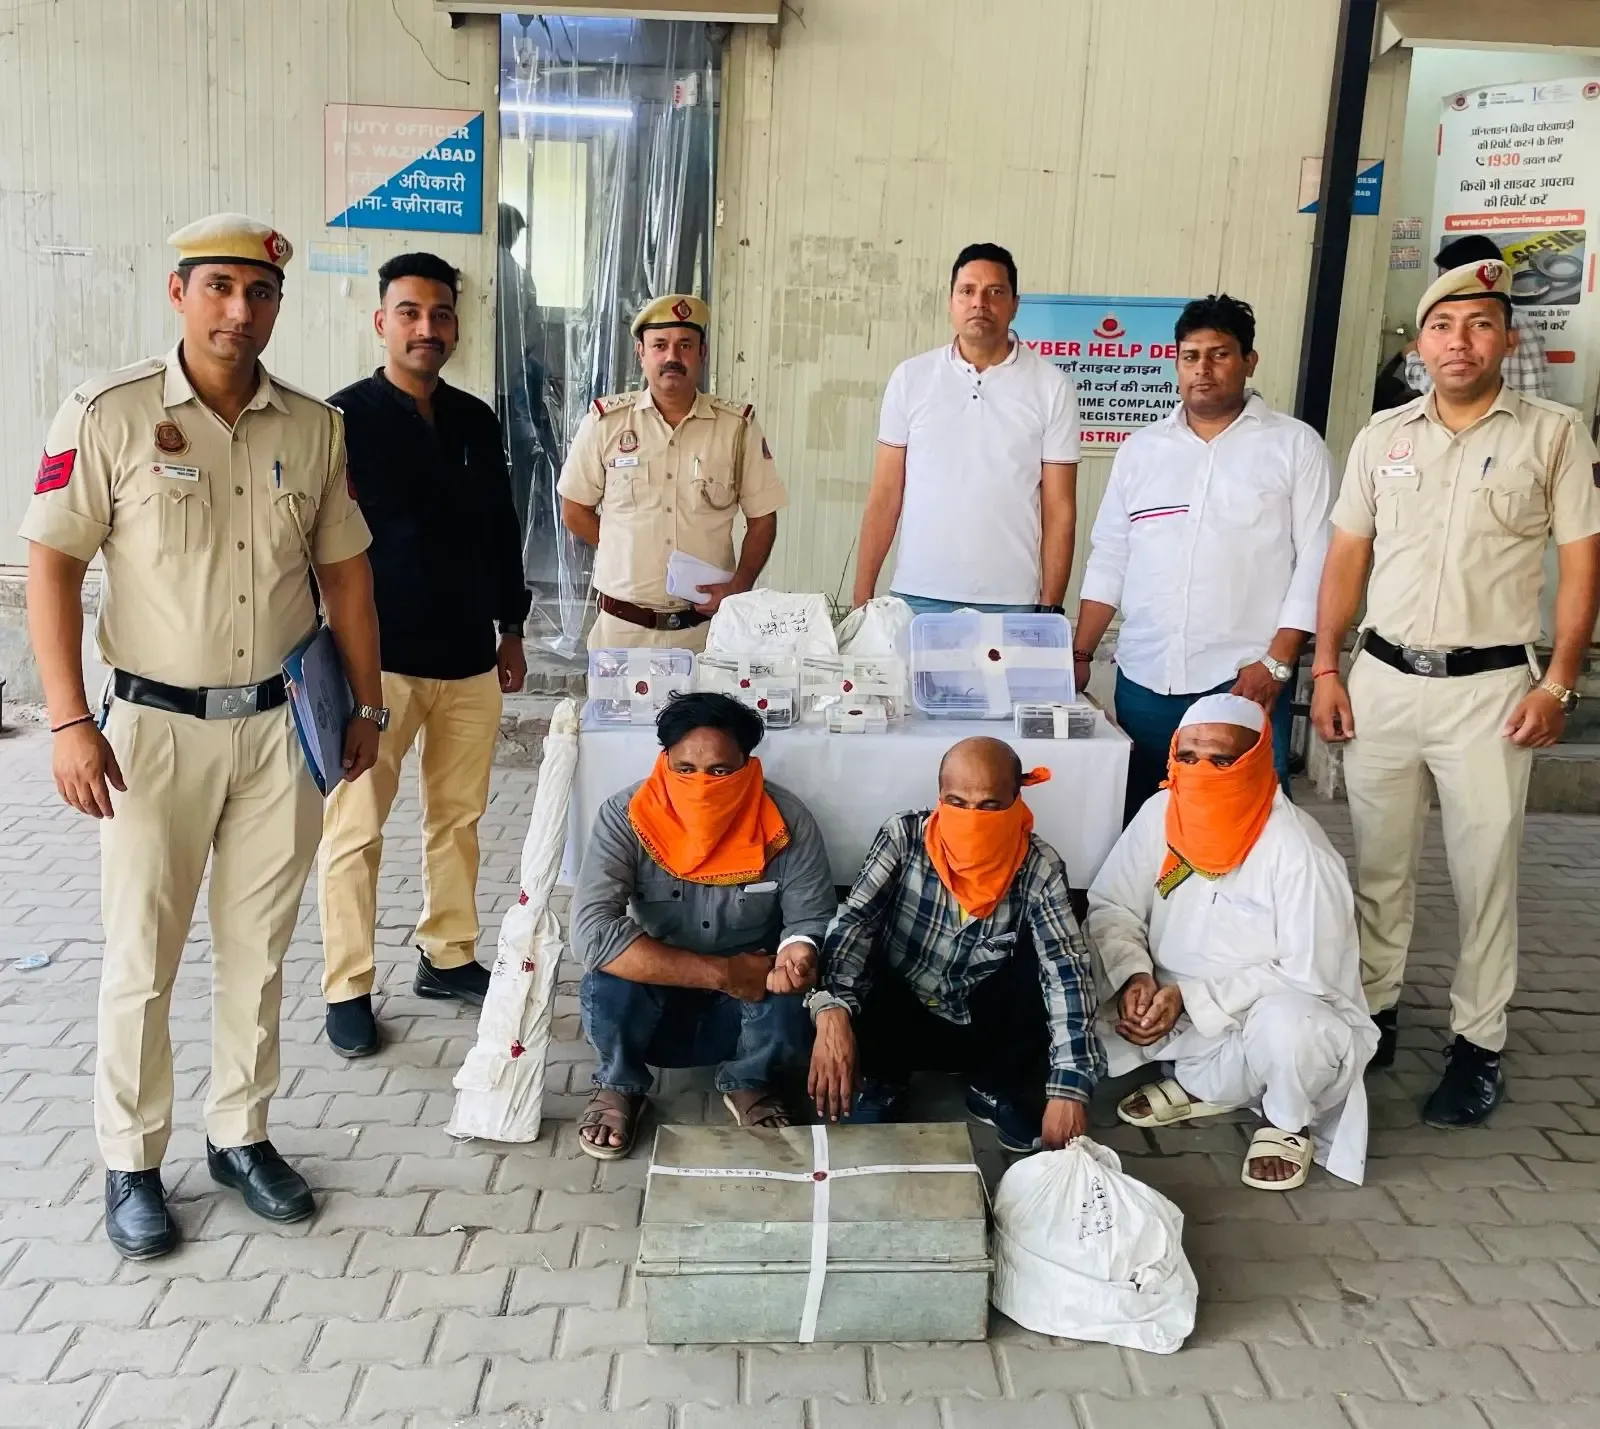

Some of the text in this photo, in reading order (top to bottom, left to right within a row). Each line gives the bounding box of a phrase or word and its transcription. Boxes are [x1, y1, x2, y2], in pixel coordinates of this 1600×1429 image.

[395, 123, 469, 139] OFFICER
[1477, 139, 1488, 150] की
[1490, 138, 1512, 149] रिपोर्ट
[1514, 137, 1534, 147] करने
[1536, 136, 1545, 146] के
[372, 144, 476, 162] WAZIRABAD
[1488, 152, 1520, 167] 1930
[398, 170, 466, 192] अधिकारी
[1460, 177, 1574, 192] किसी भी साइबर अपराध
[1484, 193, 1549, 208] की रिपोर्ट करें
[1451, 211, 1579, 228] www.cybercrime.gov.in
[1018, 341, 1177, 359] YBER HELP DE
[1079, 362, 1121, 374] साइबर
[1123, 364, 1161, 375] क्राइम
[1076, 379, 1092, 391] भी
[1094, 380, 1118, 392] दर्ज
[1120, 380, 1138, 392] की
[1141, 381, 1172, 393] जाती
[1080, 411, 1158, 422] REGISTERED
